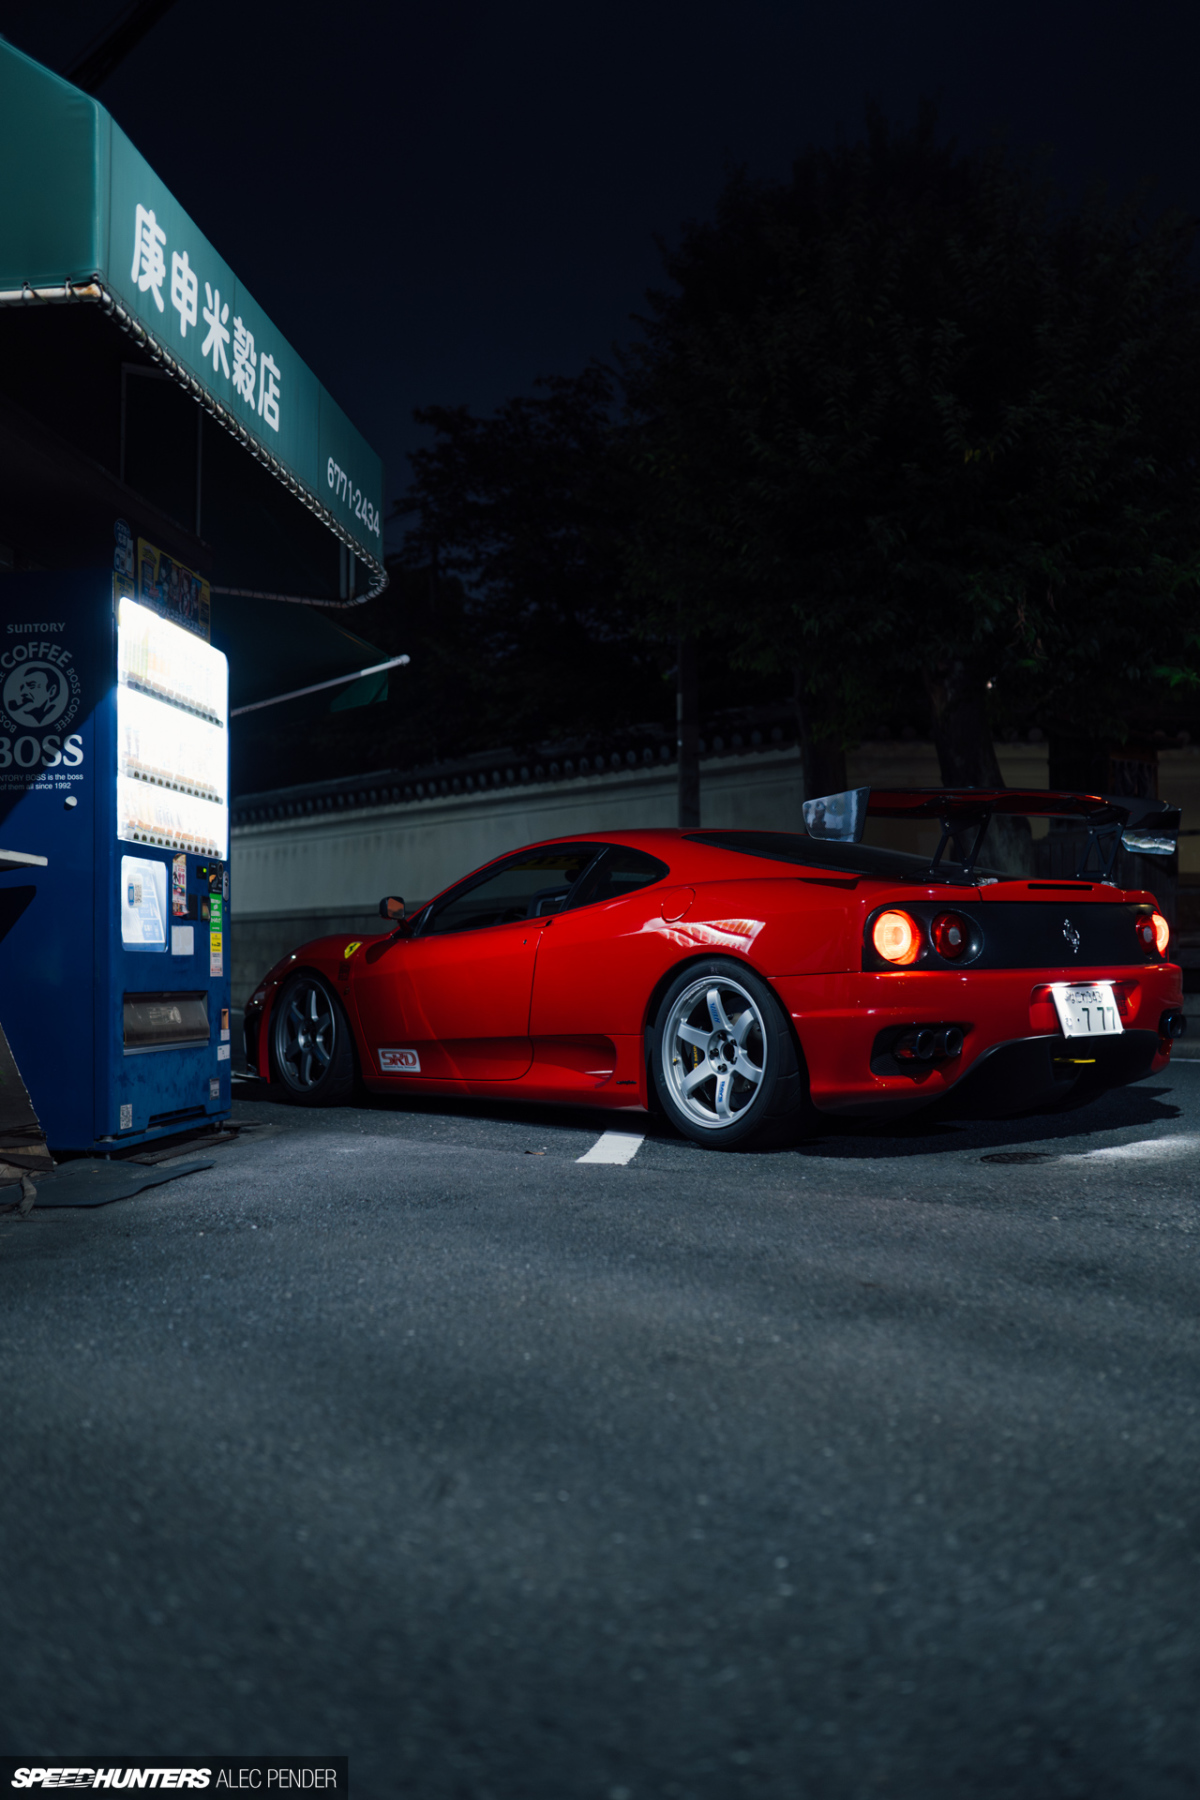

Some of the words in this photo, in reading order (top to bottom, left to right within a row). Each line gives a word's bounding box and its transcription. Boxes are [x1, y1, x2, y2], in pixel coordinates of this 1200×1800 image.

[327, 456, 380, 538] 6771-2434
[0, 641, 73, 668] COFFEE
[66, 667, 81, 695] BOSS
[54, 697, 80, 732] COFFEE
[26, 773, 46, 781] BOSS
[47, 773, 54, 781] is
[55, 773, 66, 781] the
[55, 782, 72, 790] 1992
[381, 1051, 417, 1066] SRD
